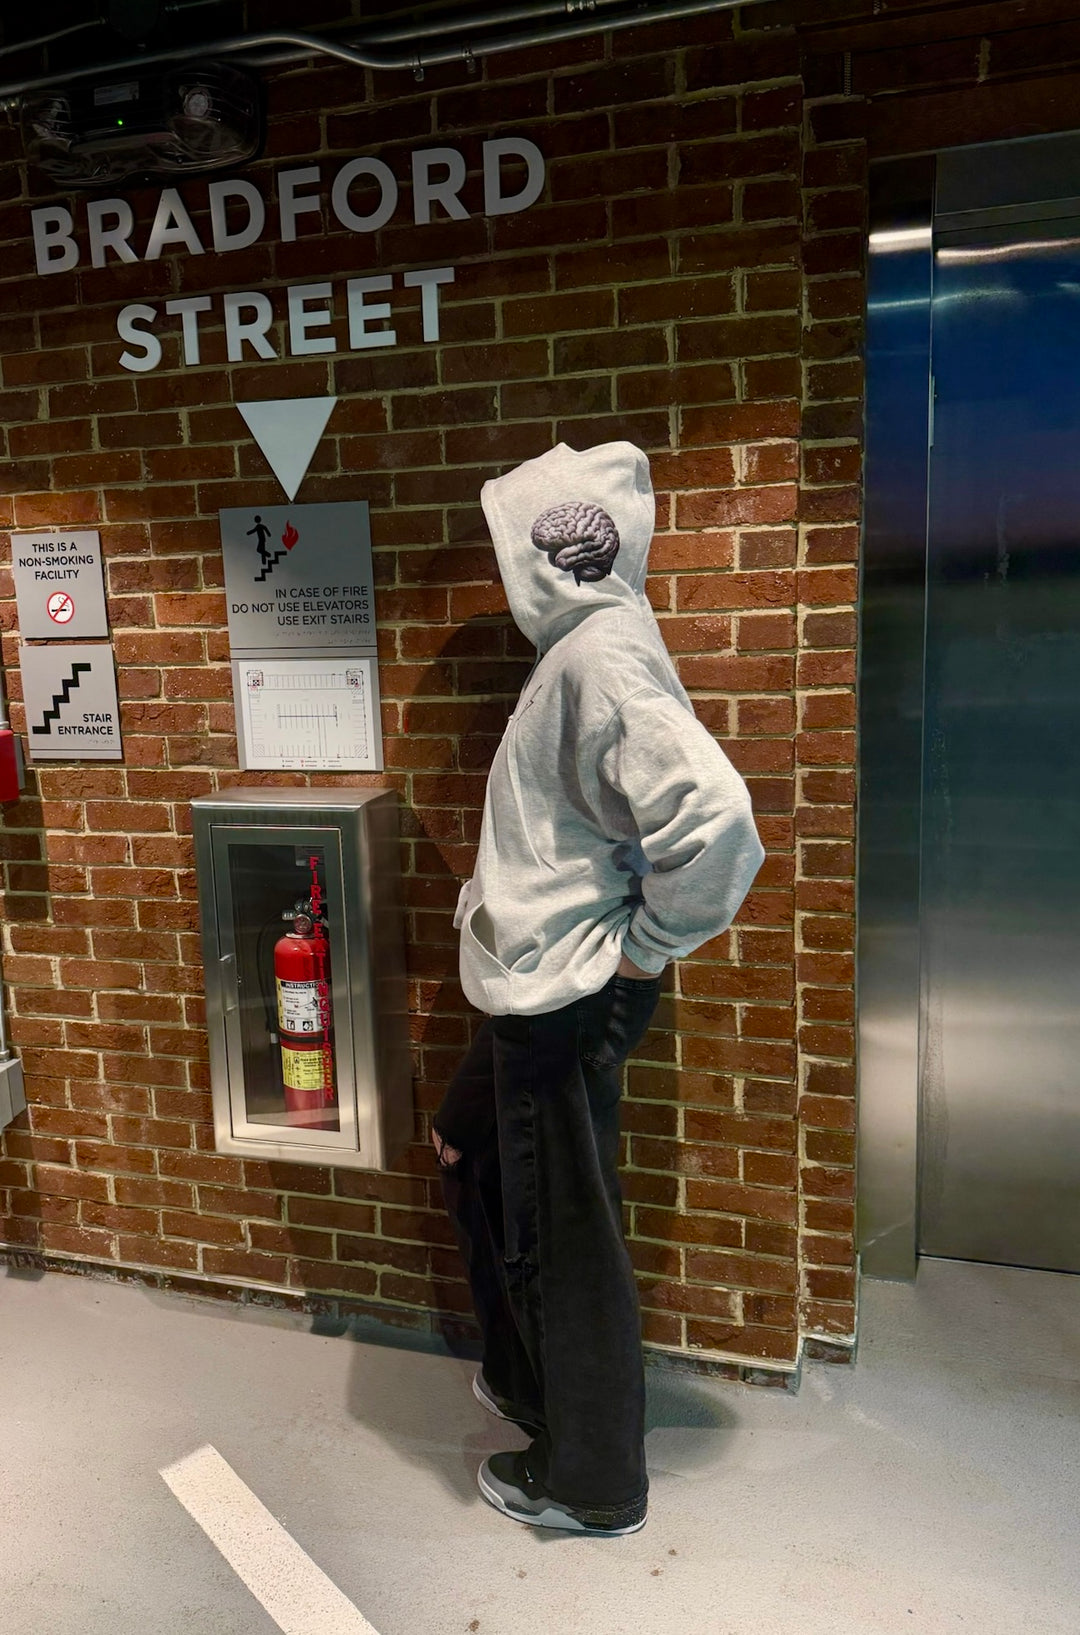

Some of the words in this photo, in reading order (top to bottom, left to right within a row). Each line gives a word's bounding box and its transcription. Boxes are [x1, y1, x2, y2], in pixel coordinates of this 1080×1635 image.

[30, 137, 546, 276] BRADFORD
[116, 266, 455, 373] STREET
[32, 543, 55, 553] THIS
[57, 542, 67, 551] IS
[69, 542, 78, 551] A
[19, 555, 94, 568] NON-SMOKING
[35, 569, 80, 581] FACILITY
[275, 588, 287, 599] IN
[289, 587, 320, 598] CASE
[322, 586, 339, 597] OF
[342, 585, 368, 596] FIRE
[232, 603, 249, 614] DO
[251, 602, 275, 613] NOT
[278, 602, 300, 612] USE
[303, 600, 369, 611] ELEVATORS
[277, 615, 299, 626] USE
[303, 614, 327, 625] EXIT
[330, 613, 370, 625] STAIRS
[82, 713, 112, 723] STAIR
[57, 725, 114, 735] ENTRANCE
[309, 856, 322, 915] FIRE
